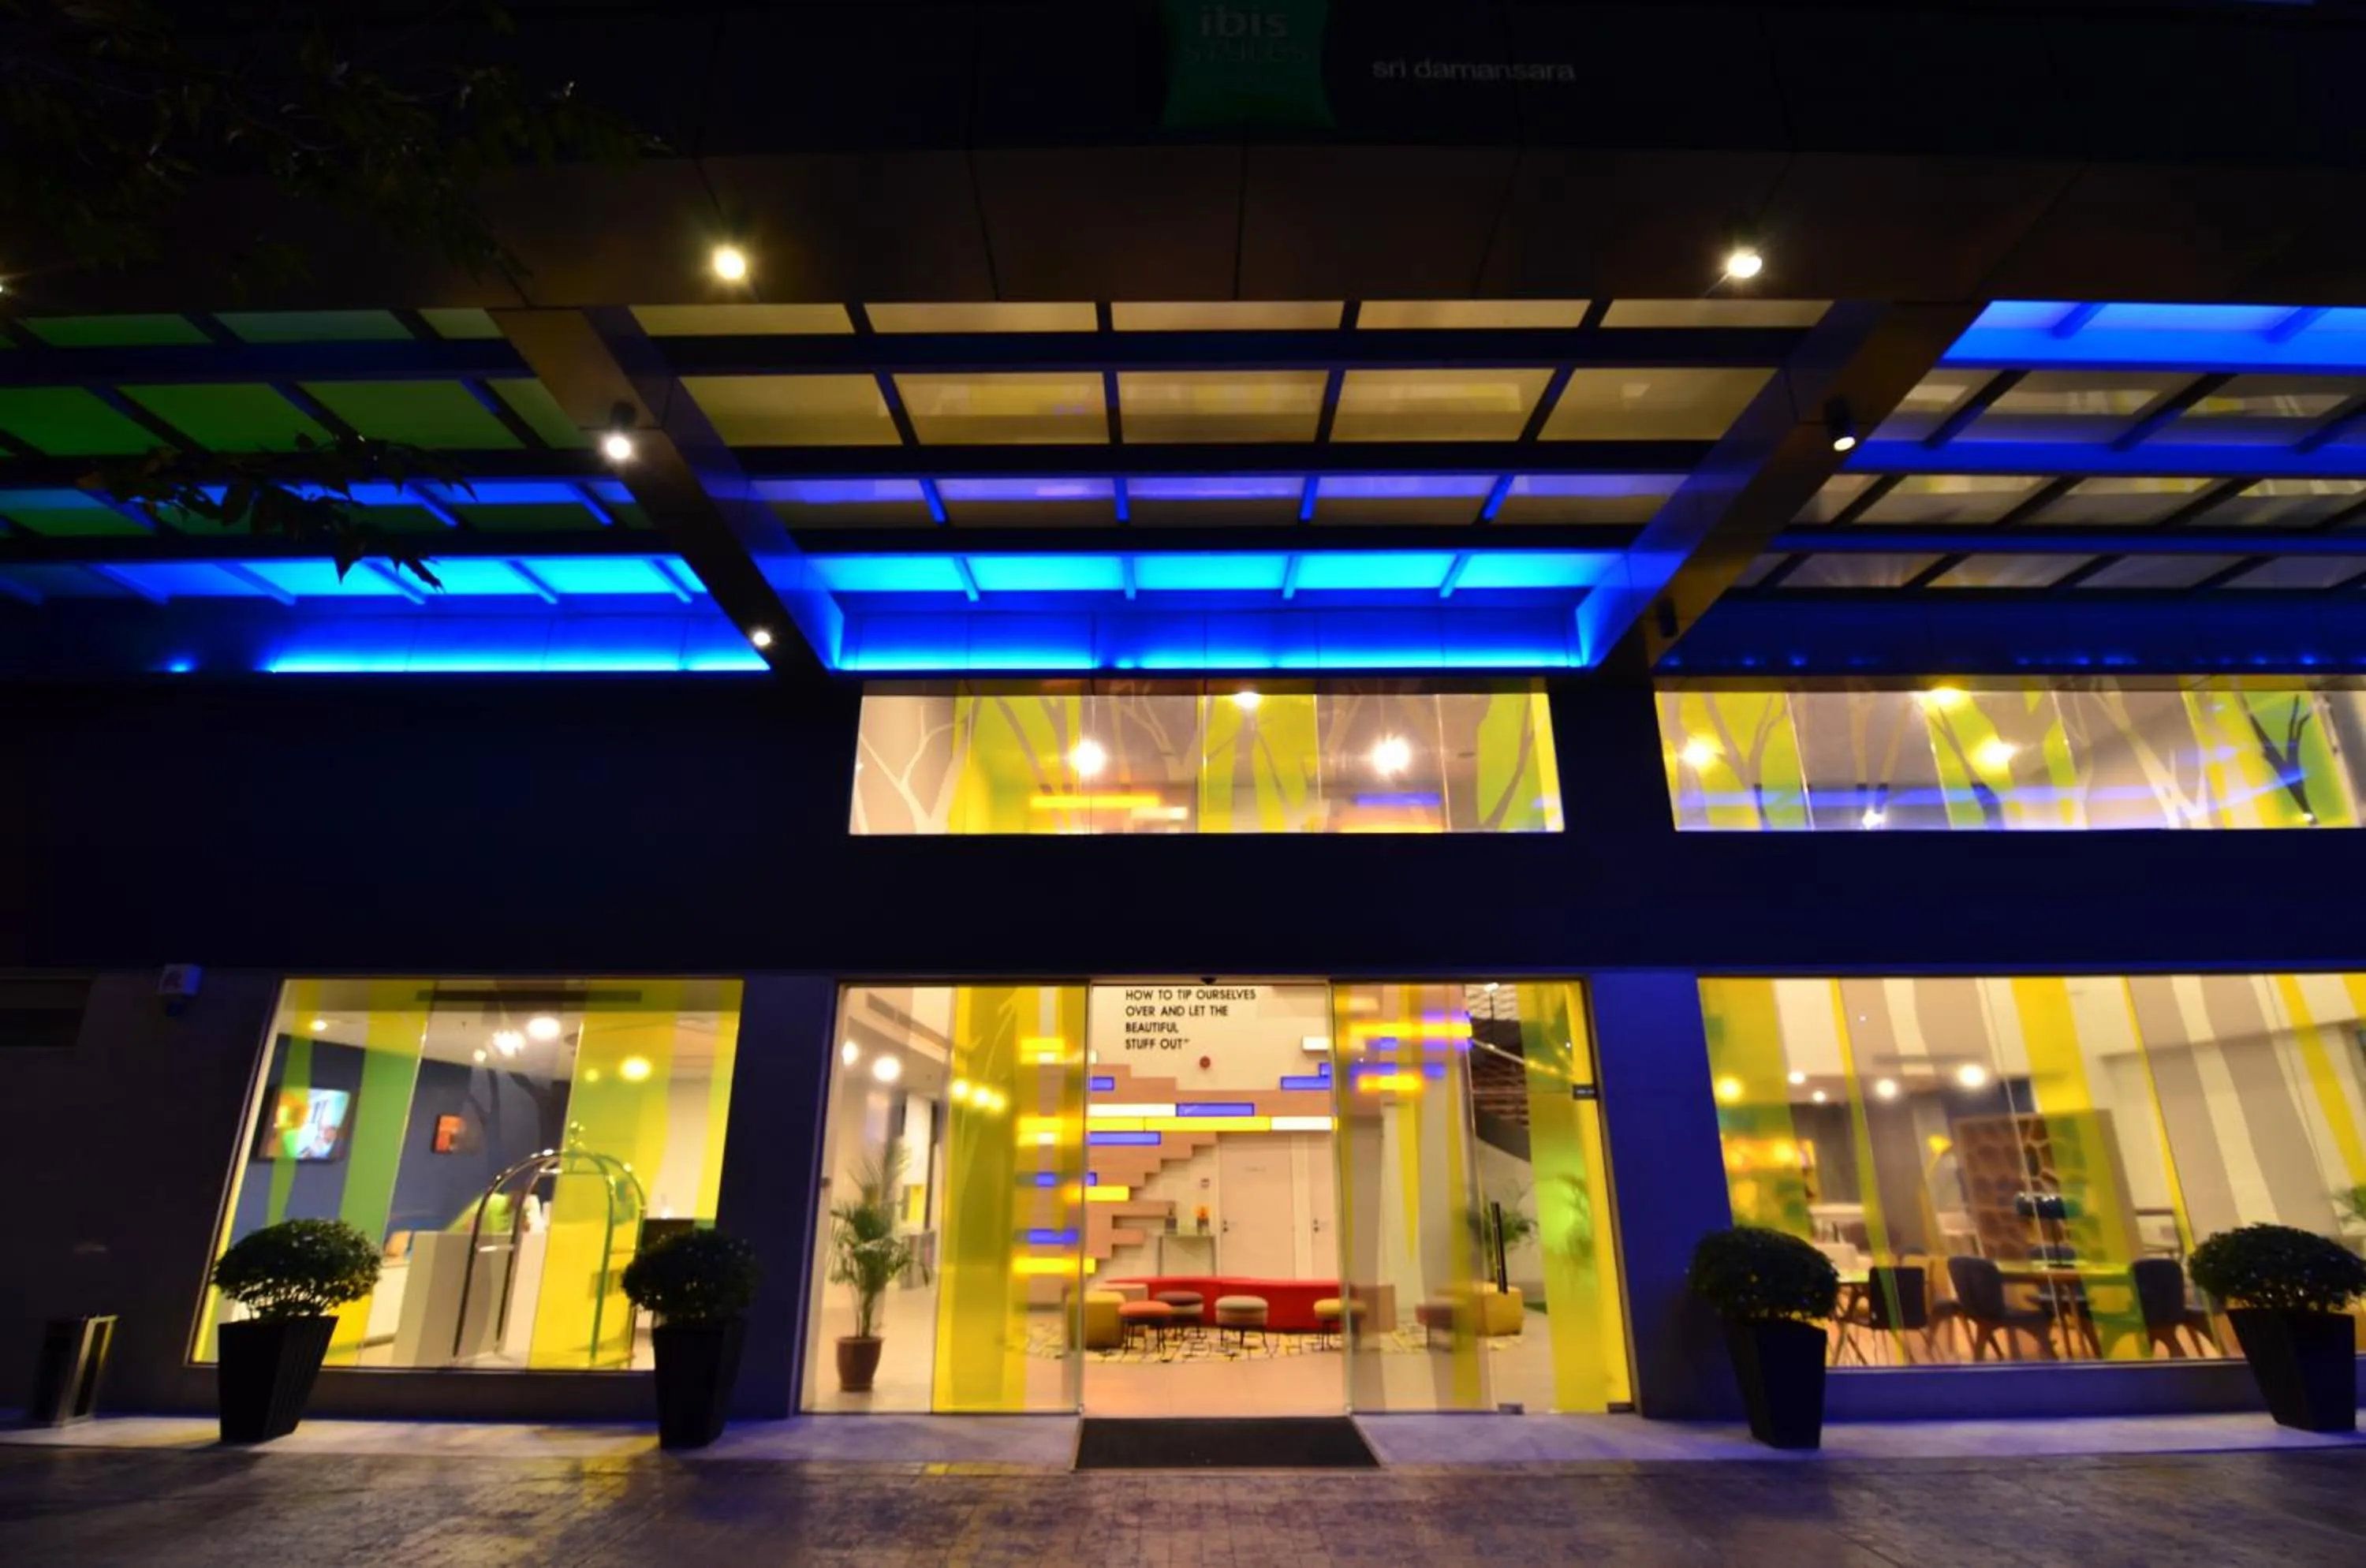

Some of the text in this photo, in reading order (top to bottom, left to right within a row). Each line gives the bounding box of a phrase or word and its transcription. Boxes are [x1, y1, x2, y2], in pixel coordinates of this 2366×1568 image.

[1201, 4, 1289, 37] ibis
[1372, 57, 1577, 83] sri damansara
[1125, 988, 1256, 1001] HOW TO TIP OURSELVES
[1125, 1005, 1229, 1017] OVER AND LET THE
[1125, 1021, 1179, 1033] BEAUTIFUL
[1125, 1038, 1155, 1051] STUFF
